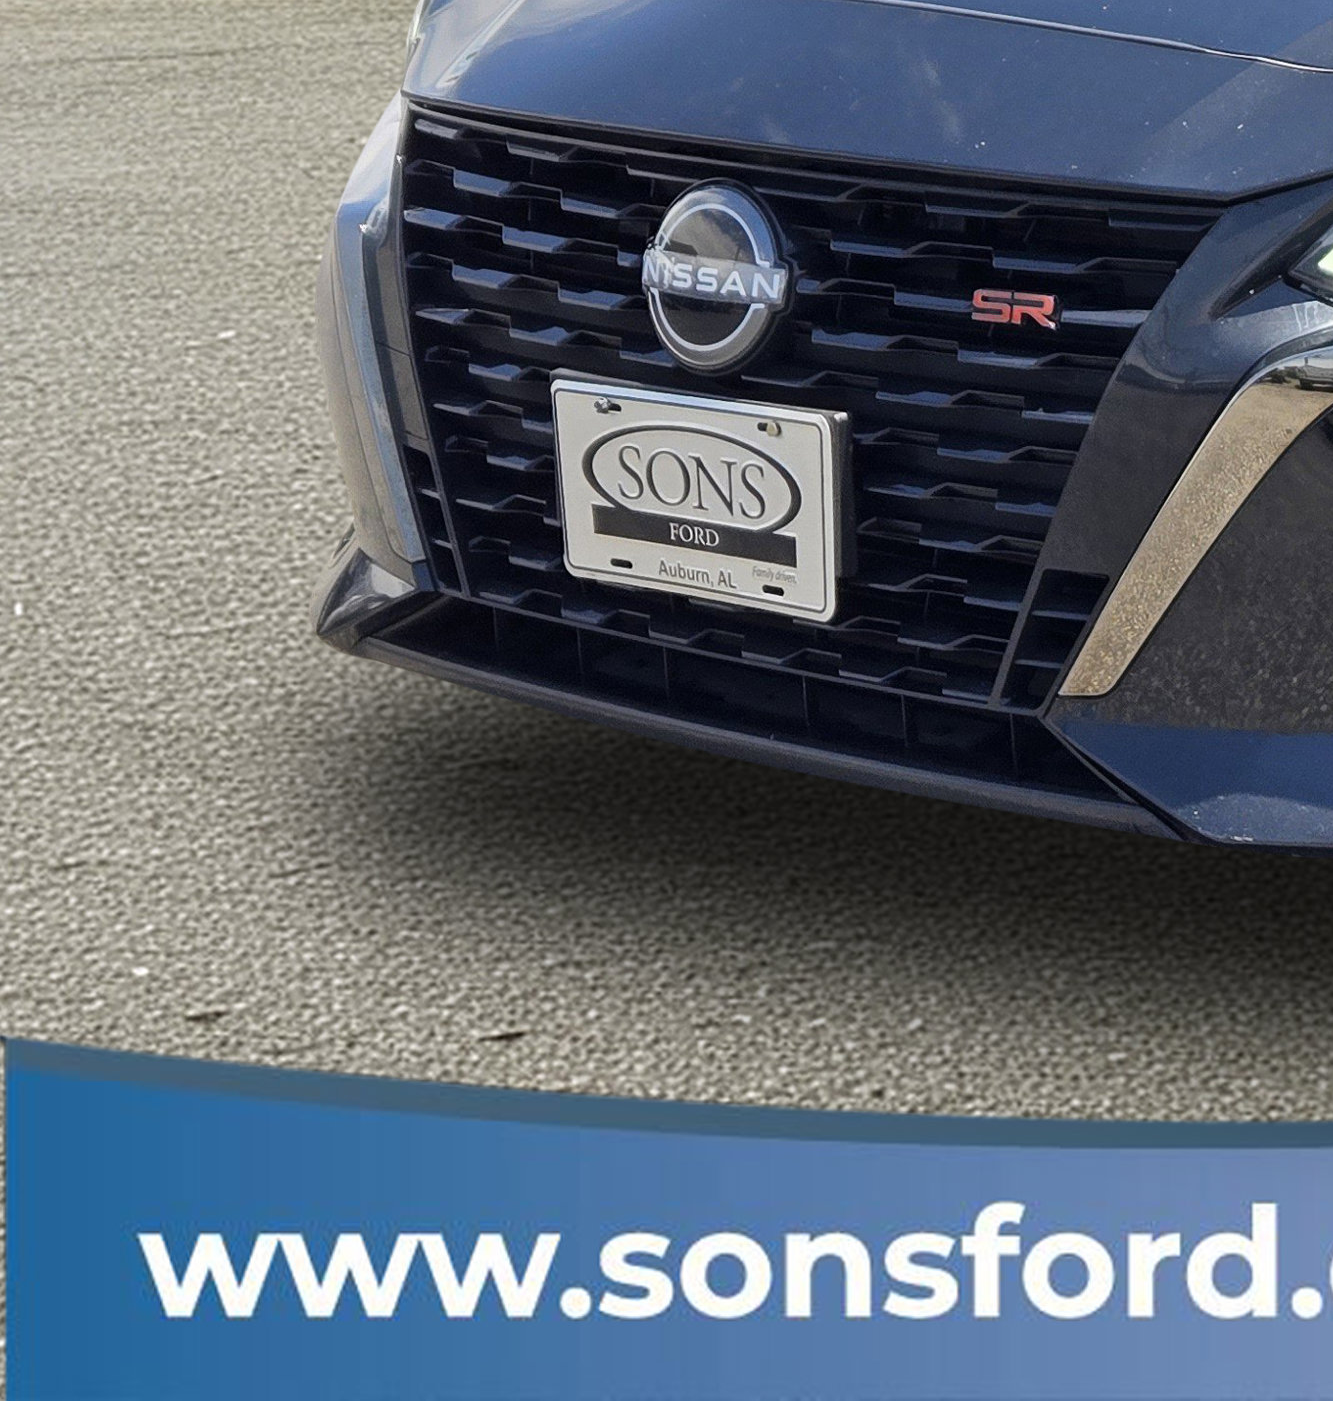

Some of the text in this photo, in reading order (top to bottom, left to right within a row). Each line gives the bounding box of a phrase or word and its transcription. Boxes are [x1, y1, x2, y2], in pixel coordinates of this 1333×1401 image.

[643, 253, 784, 299] NISSAN
[971, 288, 1058, 331] SR
[617, 445, 766, 520] SONS
[668, 522, 720, 548] FORD
[658, 559, 737, 590] Auburn, AL
